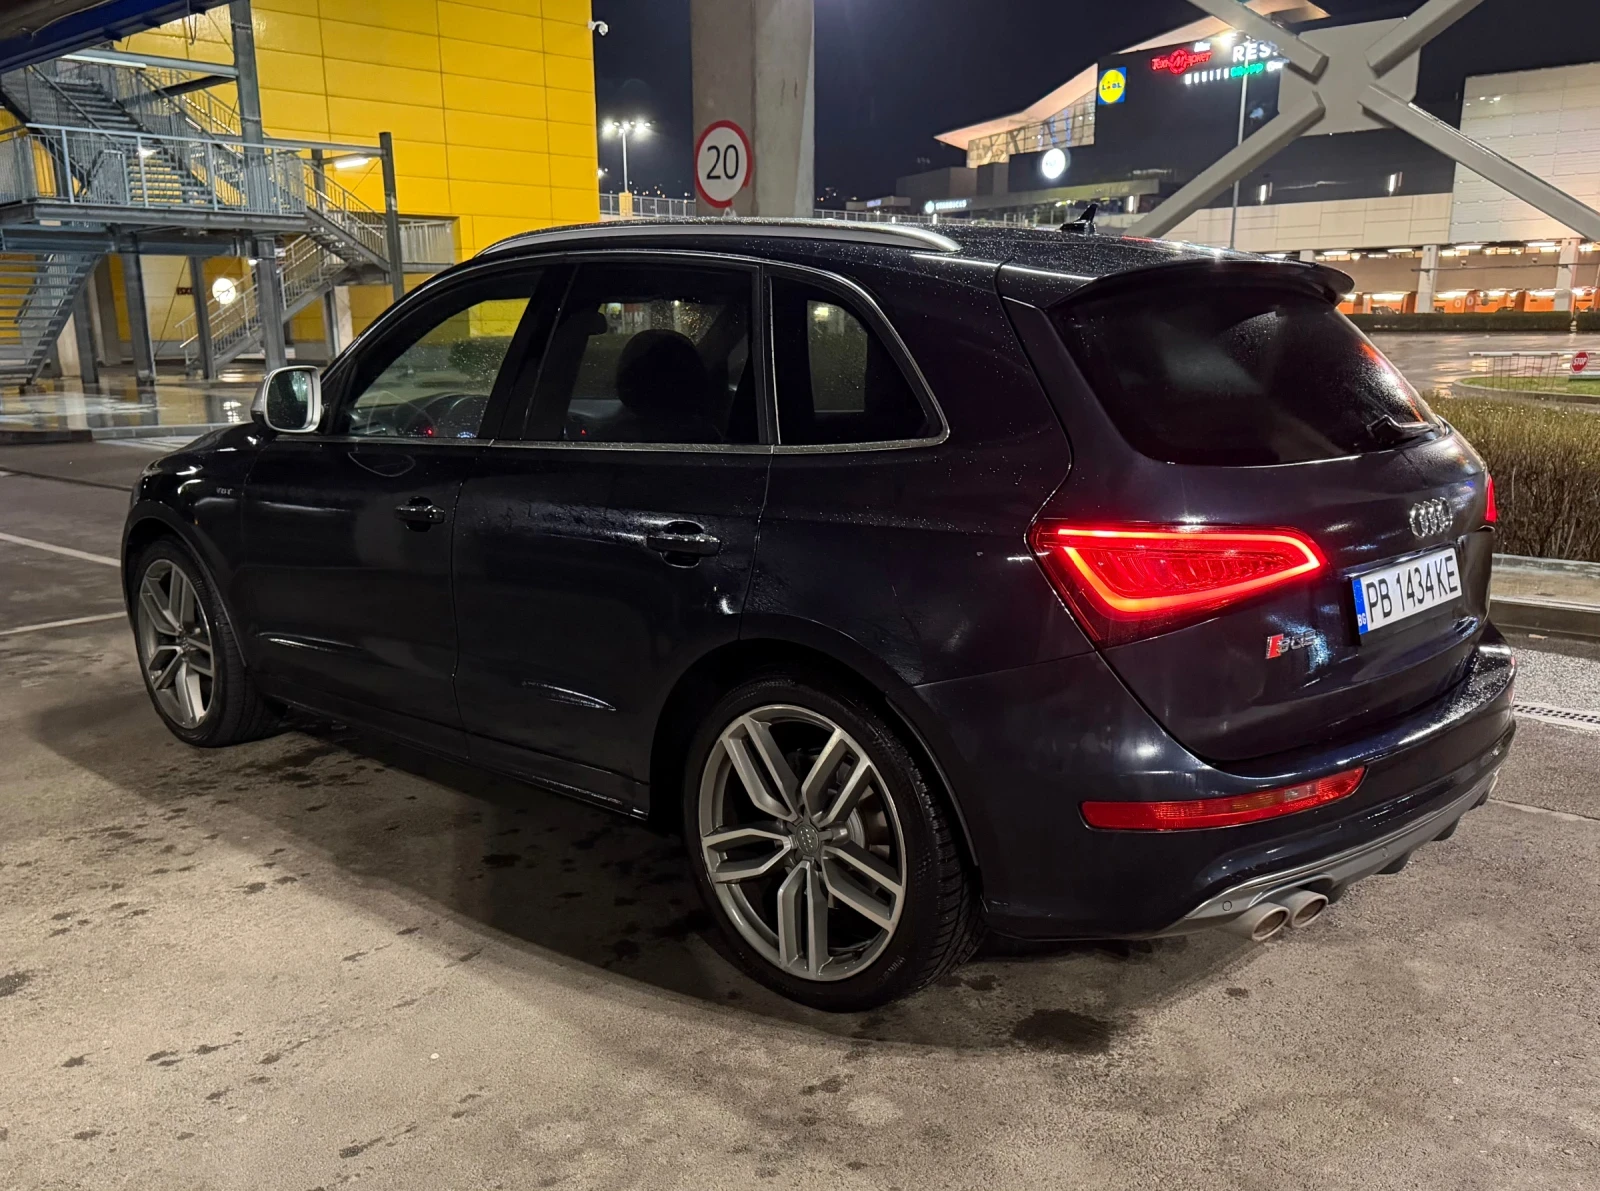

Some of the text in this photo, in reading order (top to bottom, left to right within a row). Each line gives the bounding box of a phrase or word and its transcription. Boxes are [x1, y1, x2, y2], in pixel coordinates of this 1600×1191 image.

[1232, 41, 1278, 62] RES
[706, 144, 739, 180] 20
[1572, 357, 1588, 366] STOP
[1366, 555, 1458, 623] PB 1434 KE
[1357, 612, 1367, 627] BG
